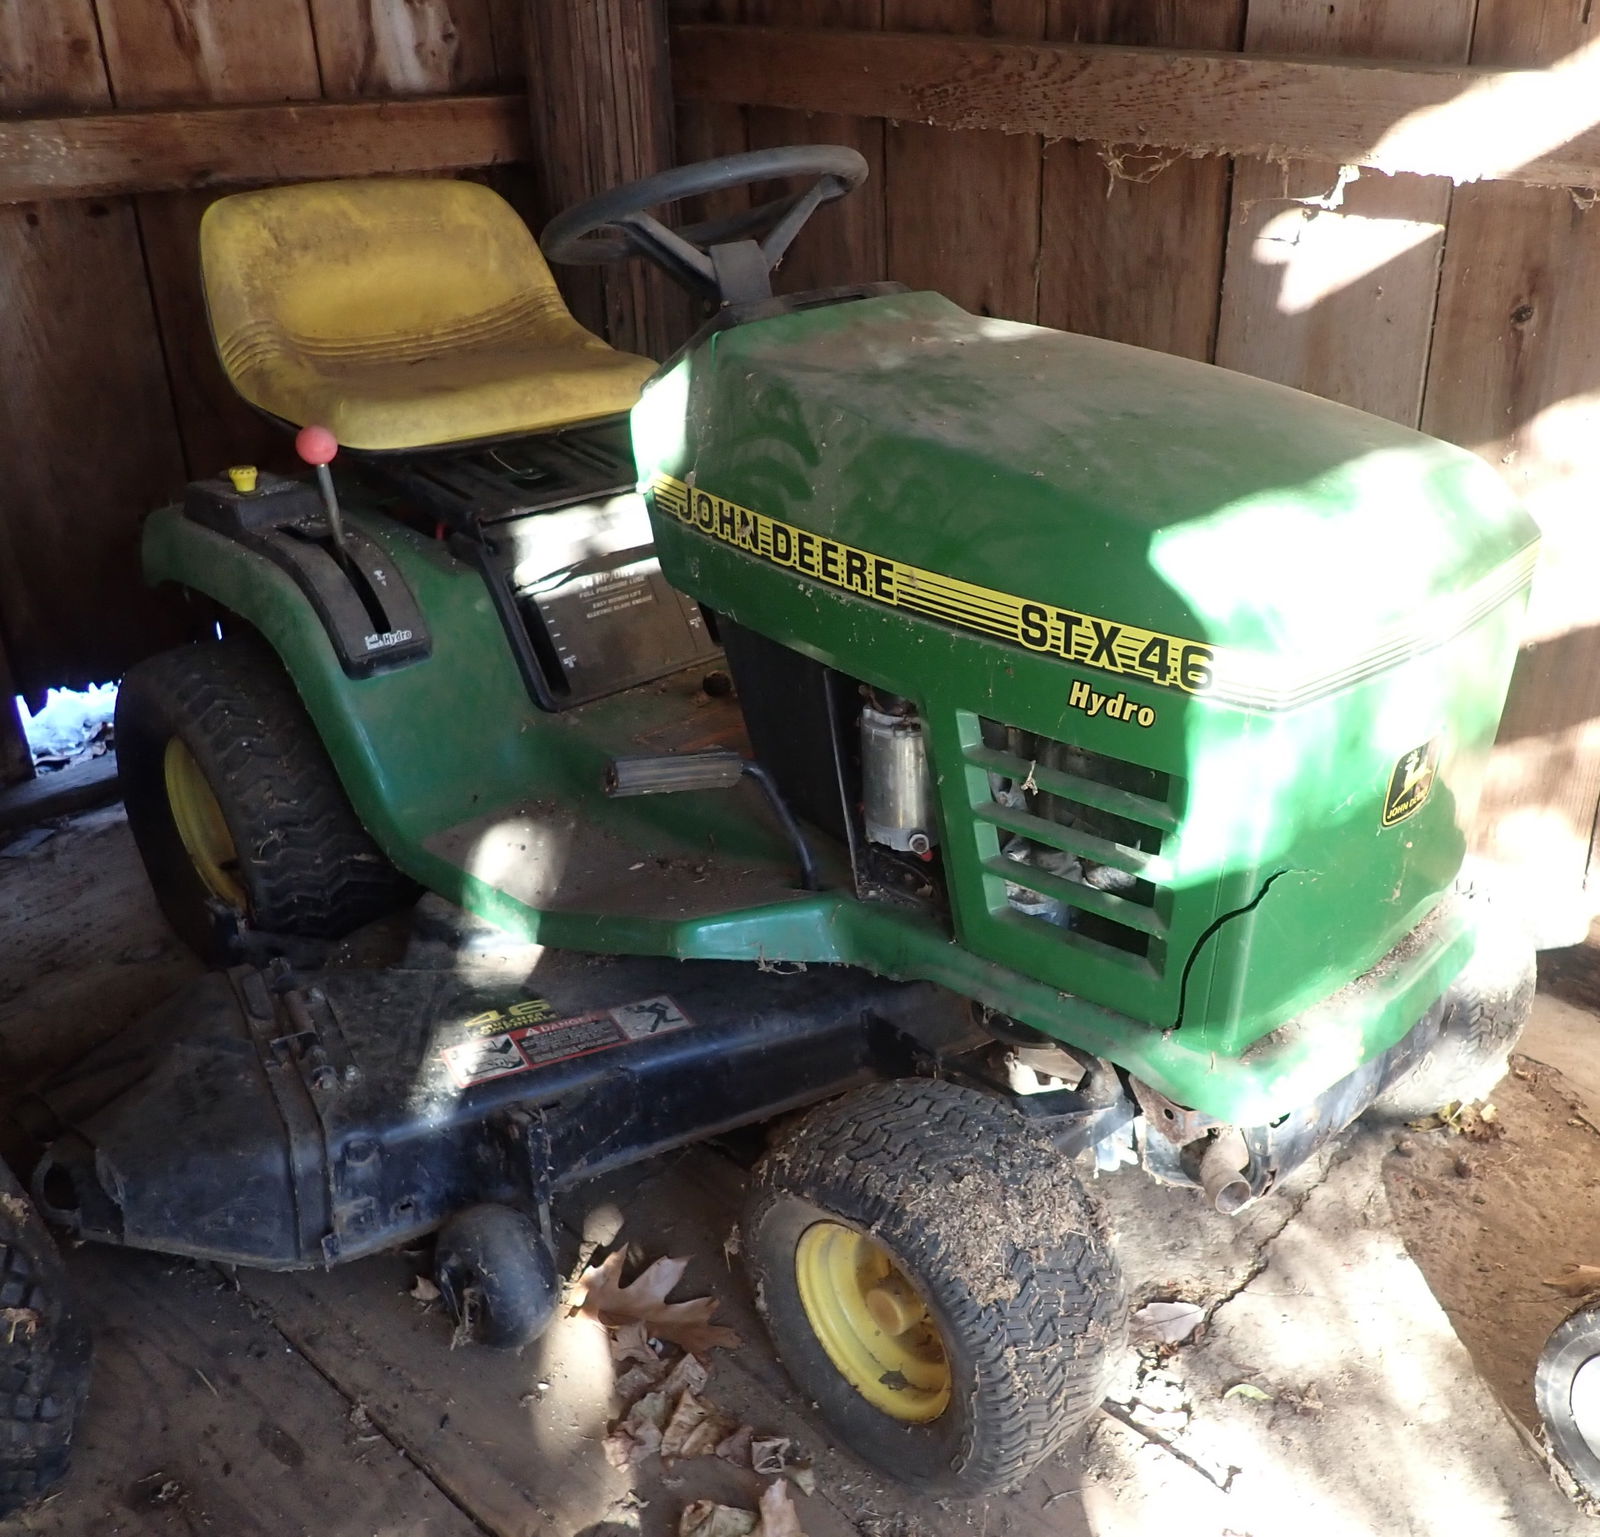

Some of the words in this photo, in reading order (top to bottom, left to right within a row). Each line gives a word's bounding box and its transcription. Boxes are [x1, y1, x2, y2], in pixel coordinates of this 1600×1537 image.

[678, 486, 760, 553] JOHN
[771, 521, 897, 603] DEERE
[383, 630, 412, 645] Hydro
[1021, 604, 1122, 668] STX
[1138, 636, 1215, 690] 46
[1069, 681, 1156, 728] Hydro
[1386, 802, 1409, 820] JOHN
[464, 999, 551, 1028] 46
[540, 1014, 594, 1033] DANGER
